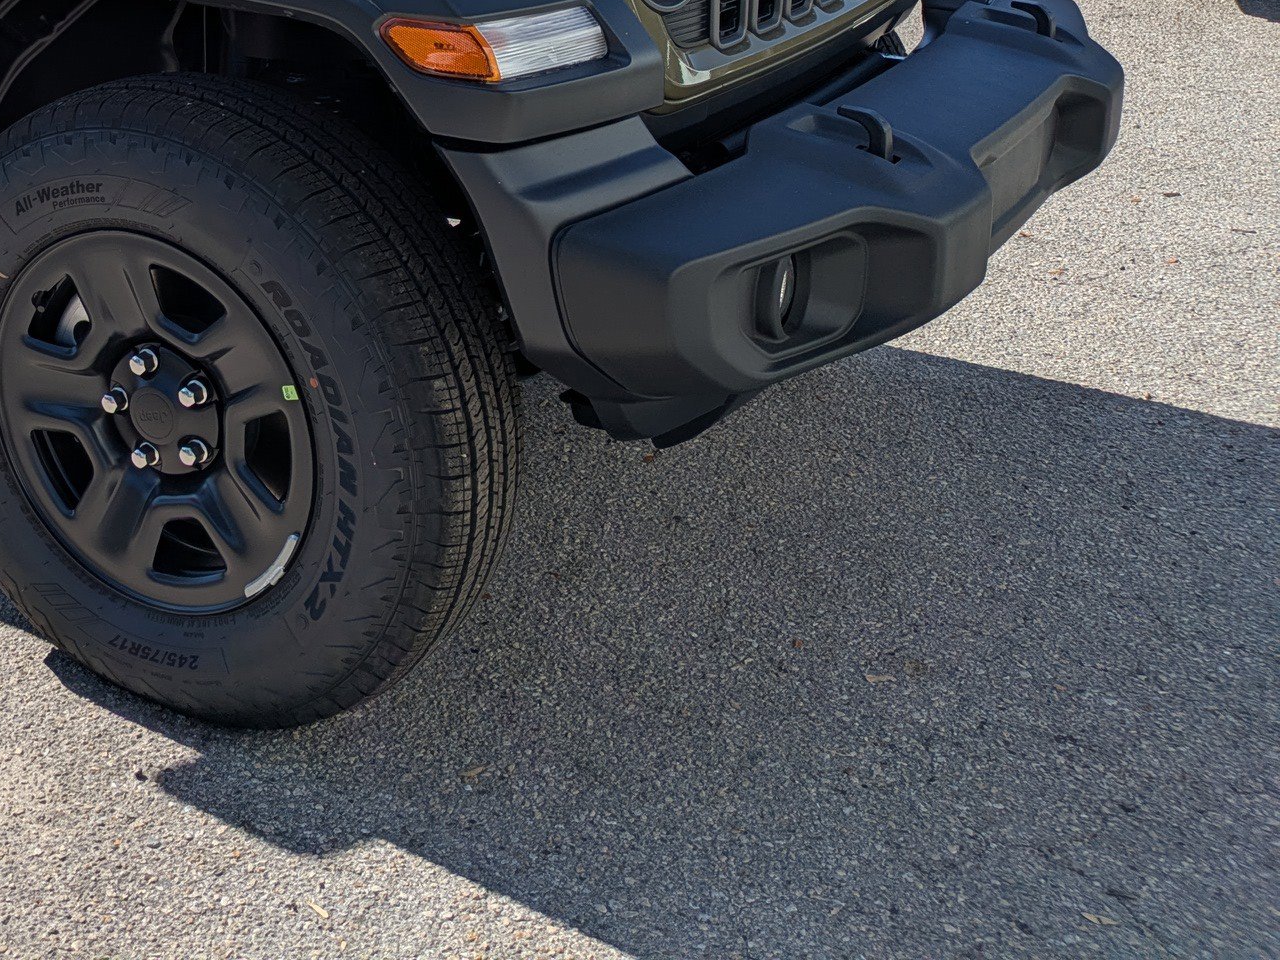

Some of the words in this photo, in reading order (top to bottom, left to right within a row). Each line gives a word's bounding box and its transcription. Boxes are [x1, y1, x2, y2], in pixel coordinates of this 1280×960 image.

[15, 180, 104, 216] All-Weather
[52, 195, 106, 210] Performance
[260, 279, 358, 498] ROADIAN
[108, 634, 200, 671] 245/75R17
